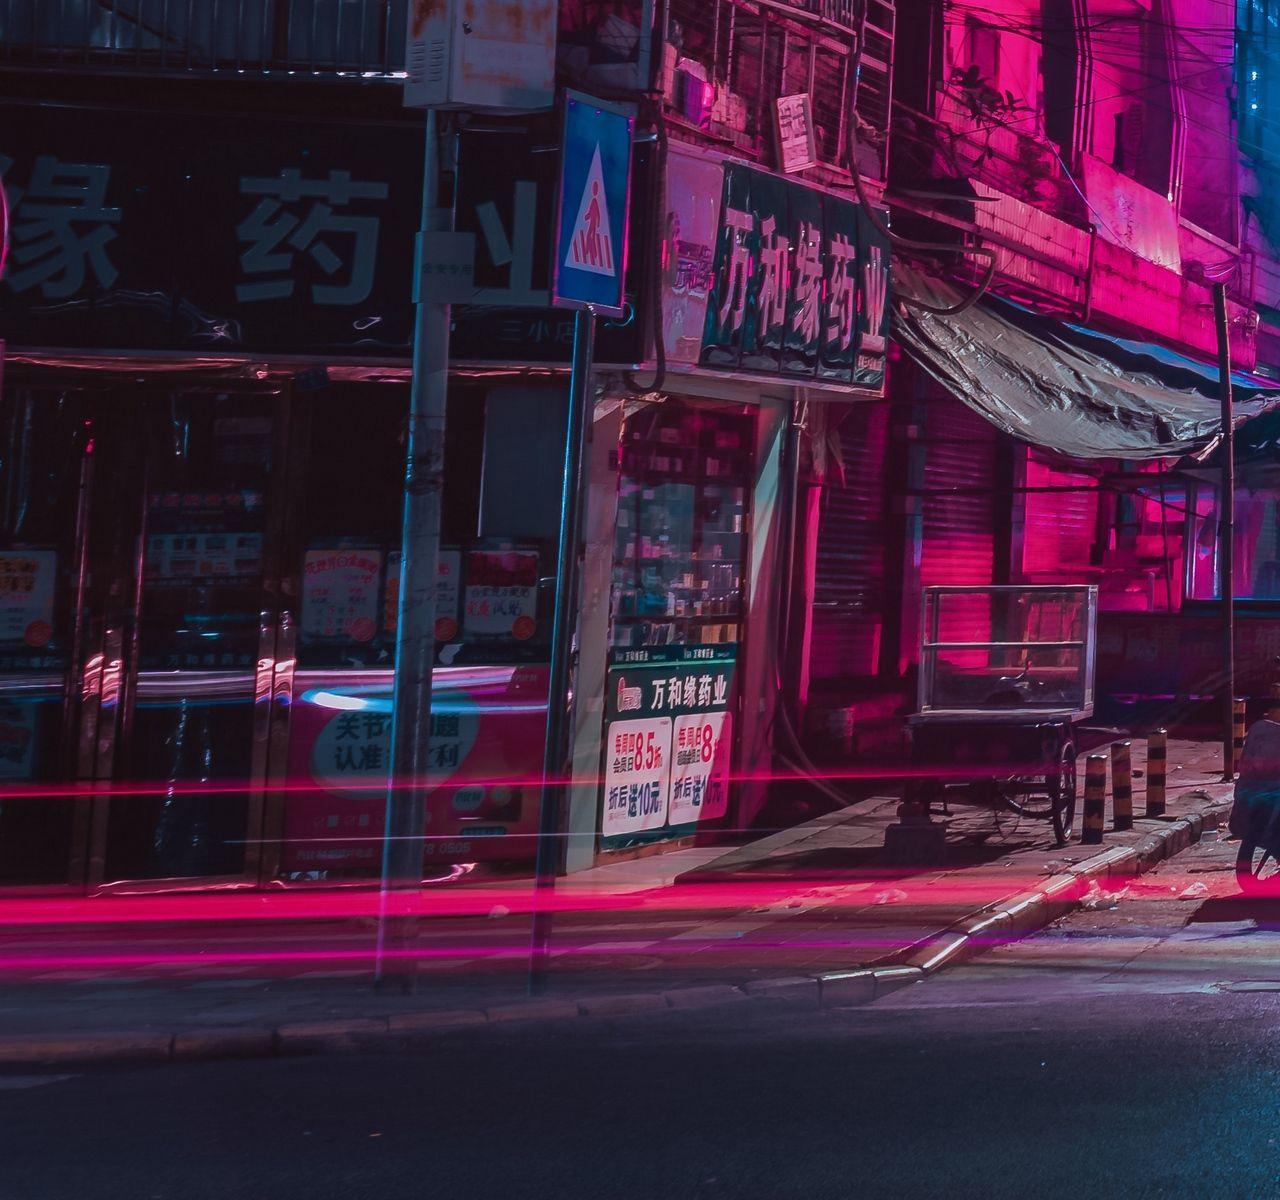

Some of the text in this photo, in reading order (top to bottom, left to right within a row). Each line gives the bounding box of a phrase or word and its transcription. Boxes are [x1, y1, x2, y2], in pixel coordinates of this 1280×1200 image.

[719, 207, 888, 352] 万和缘药业
[651, 674, 728, 710] 万和缘药业
